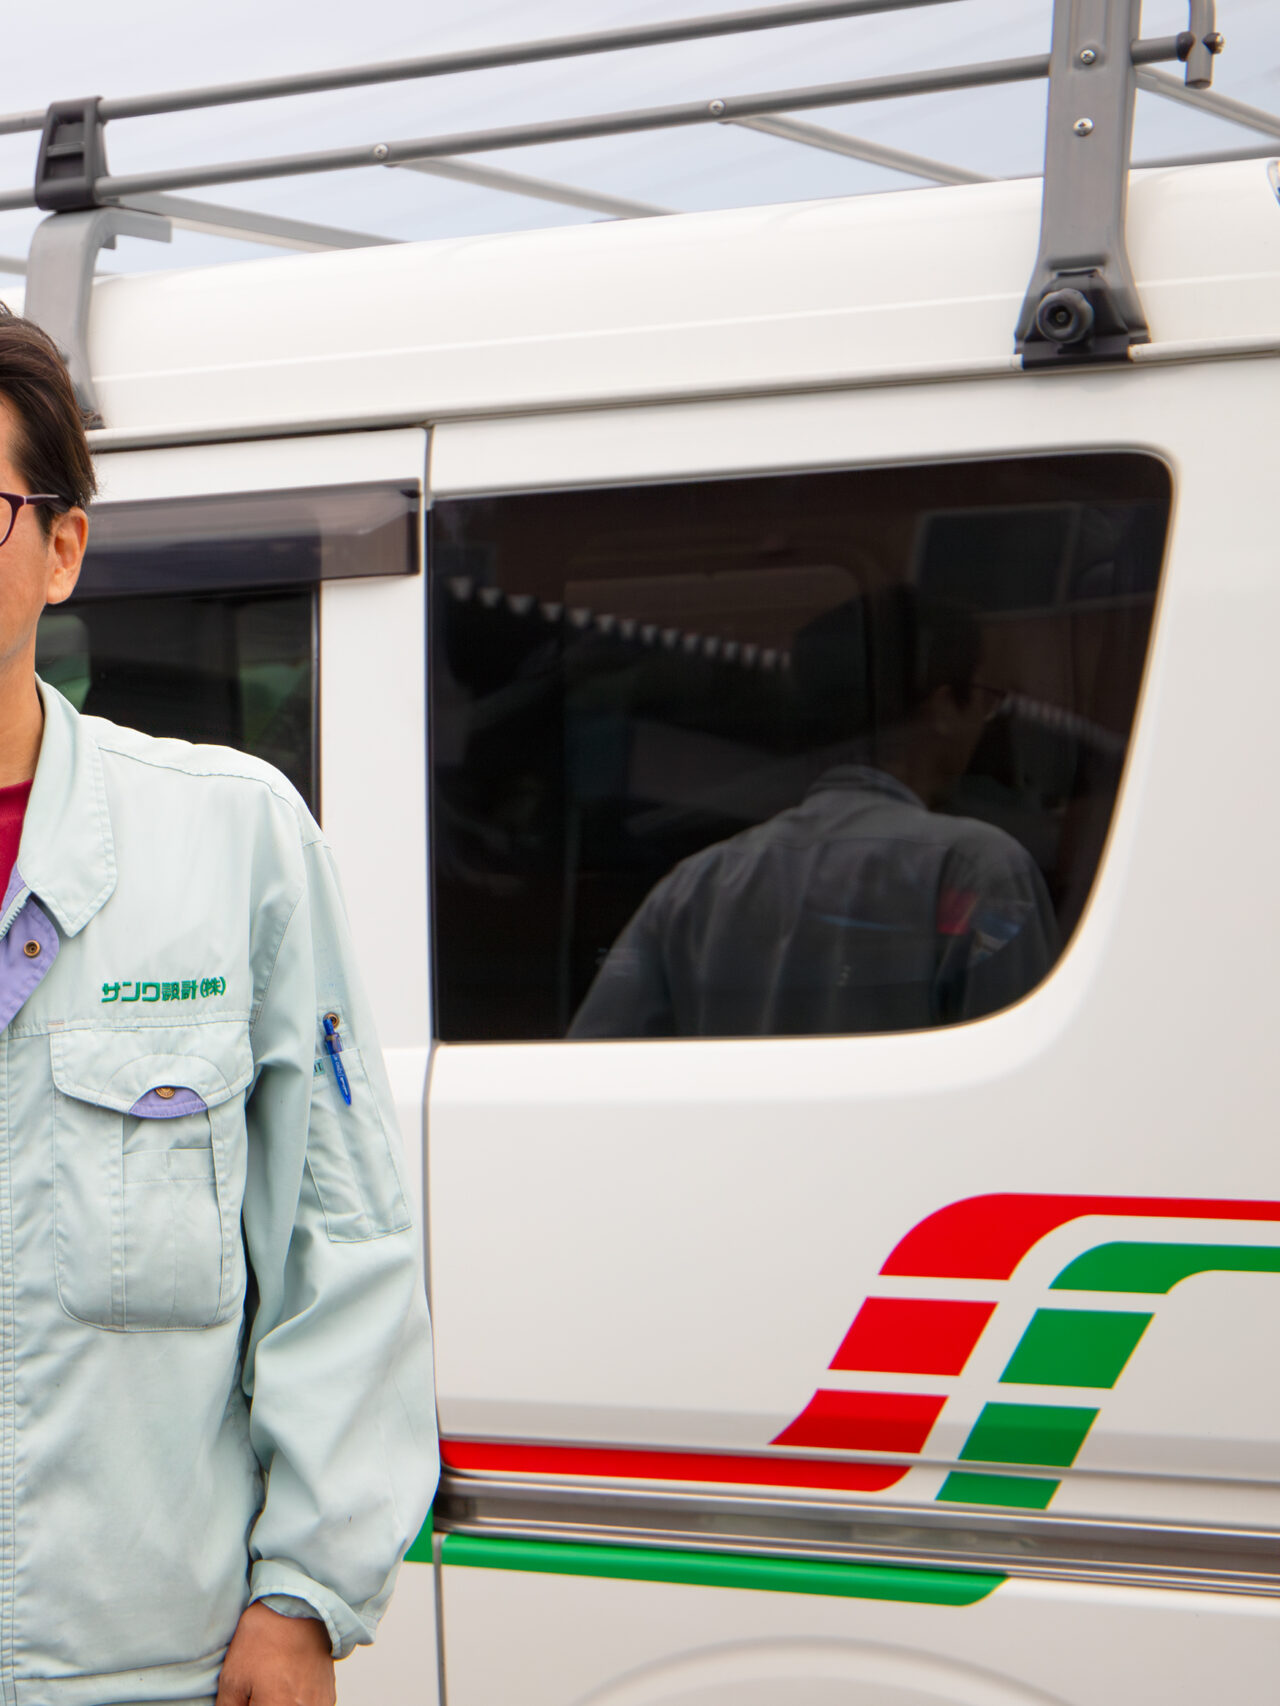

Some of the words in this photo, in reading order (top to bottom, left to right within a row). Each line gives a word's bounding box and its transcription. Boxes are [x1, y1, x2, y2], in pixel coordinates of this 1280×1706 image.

[102, 977, 226, 1003] サンワ設計(株)
